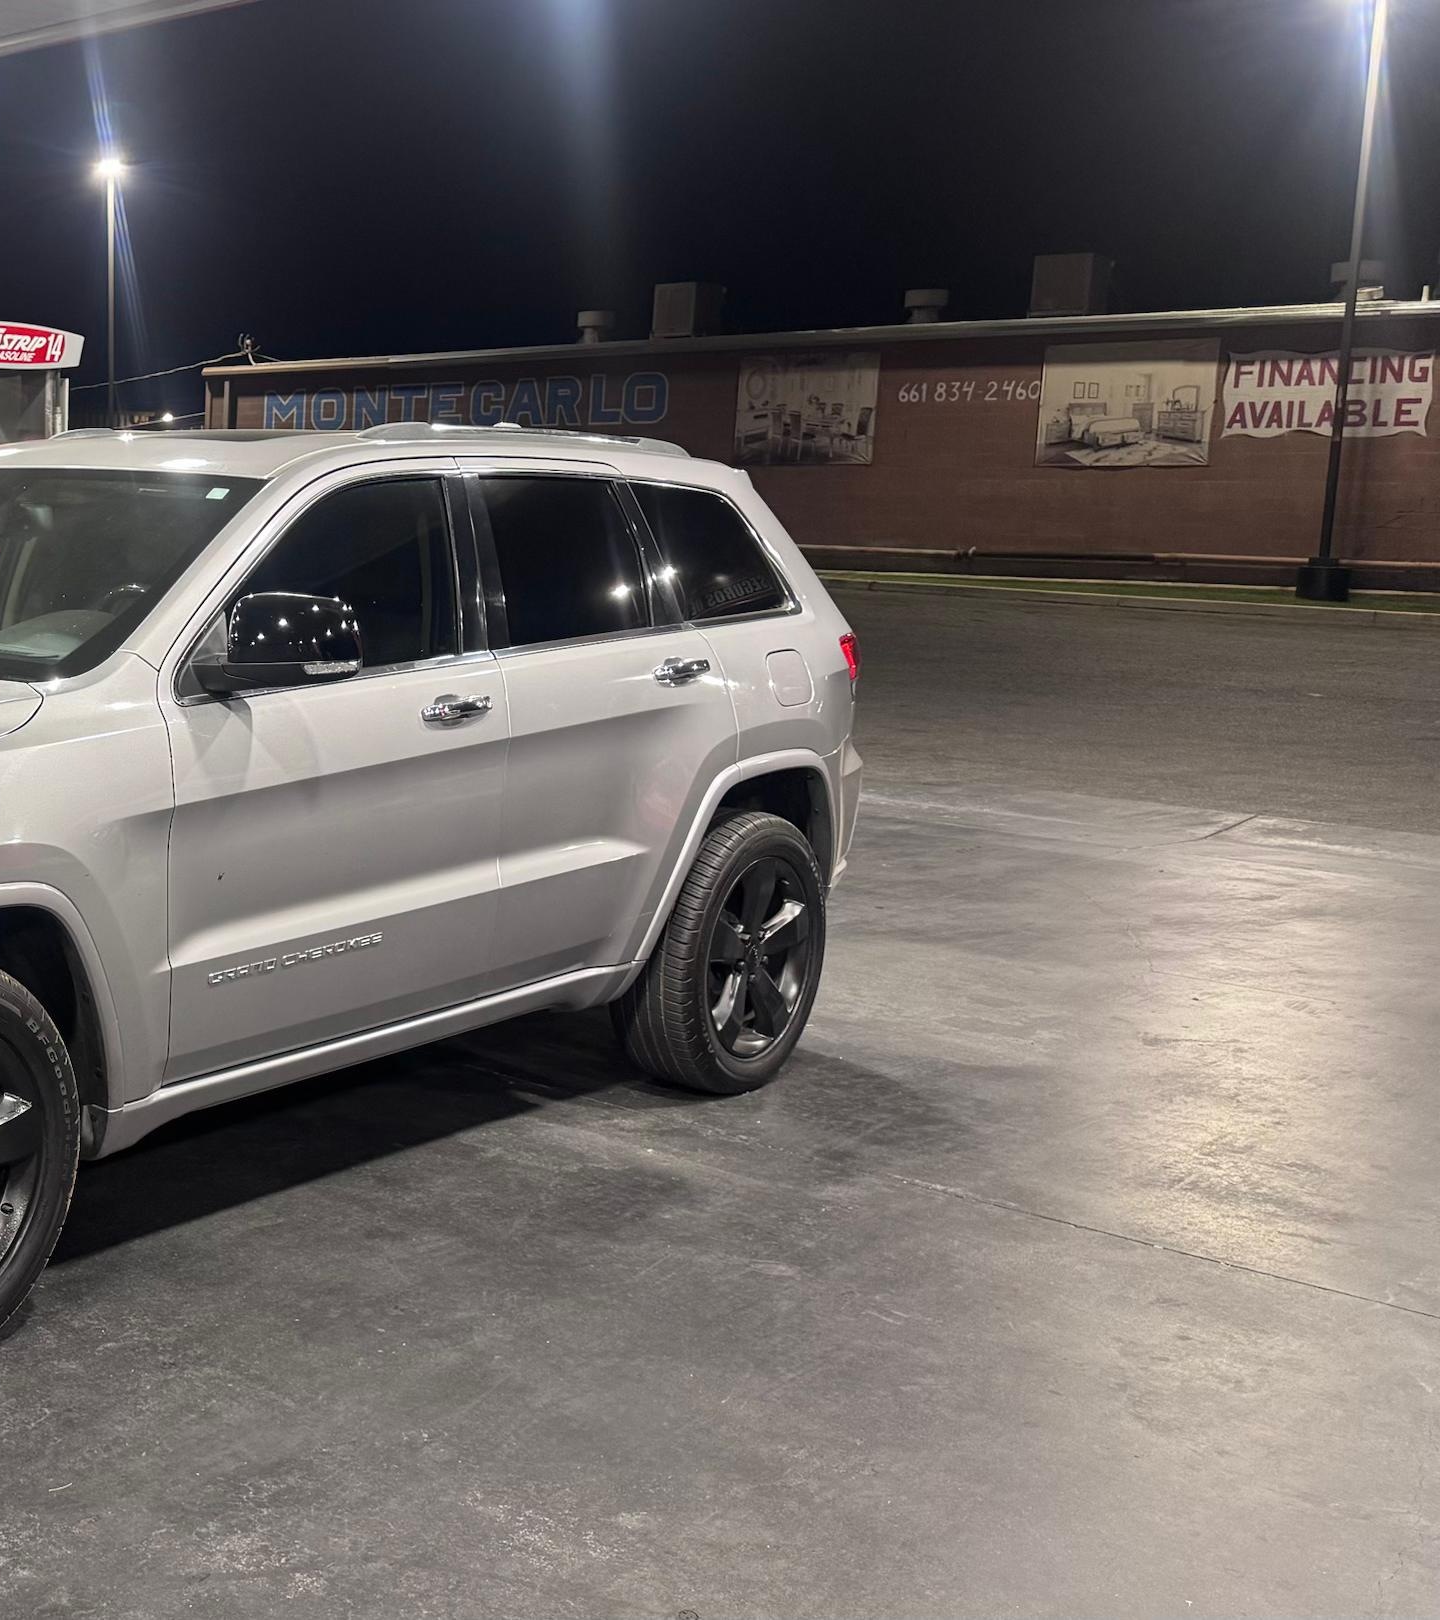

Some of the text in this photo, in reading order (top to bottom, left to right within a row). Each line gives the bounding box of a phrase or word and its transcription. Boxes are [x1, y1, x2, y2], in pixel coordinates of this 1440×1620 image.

[45, 333, 63, 361] 14
[1233, 354, 1431, 389] FINANCING
[898, 380, 1041, 403] 661 834-2460
[1226, 398, 1422, 429] AVAILABLE
[207, 931, 383, 987] GRAND CHEROKEE
